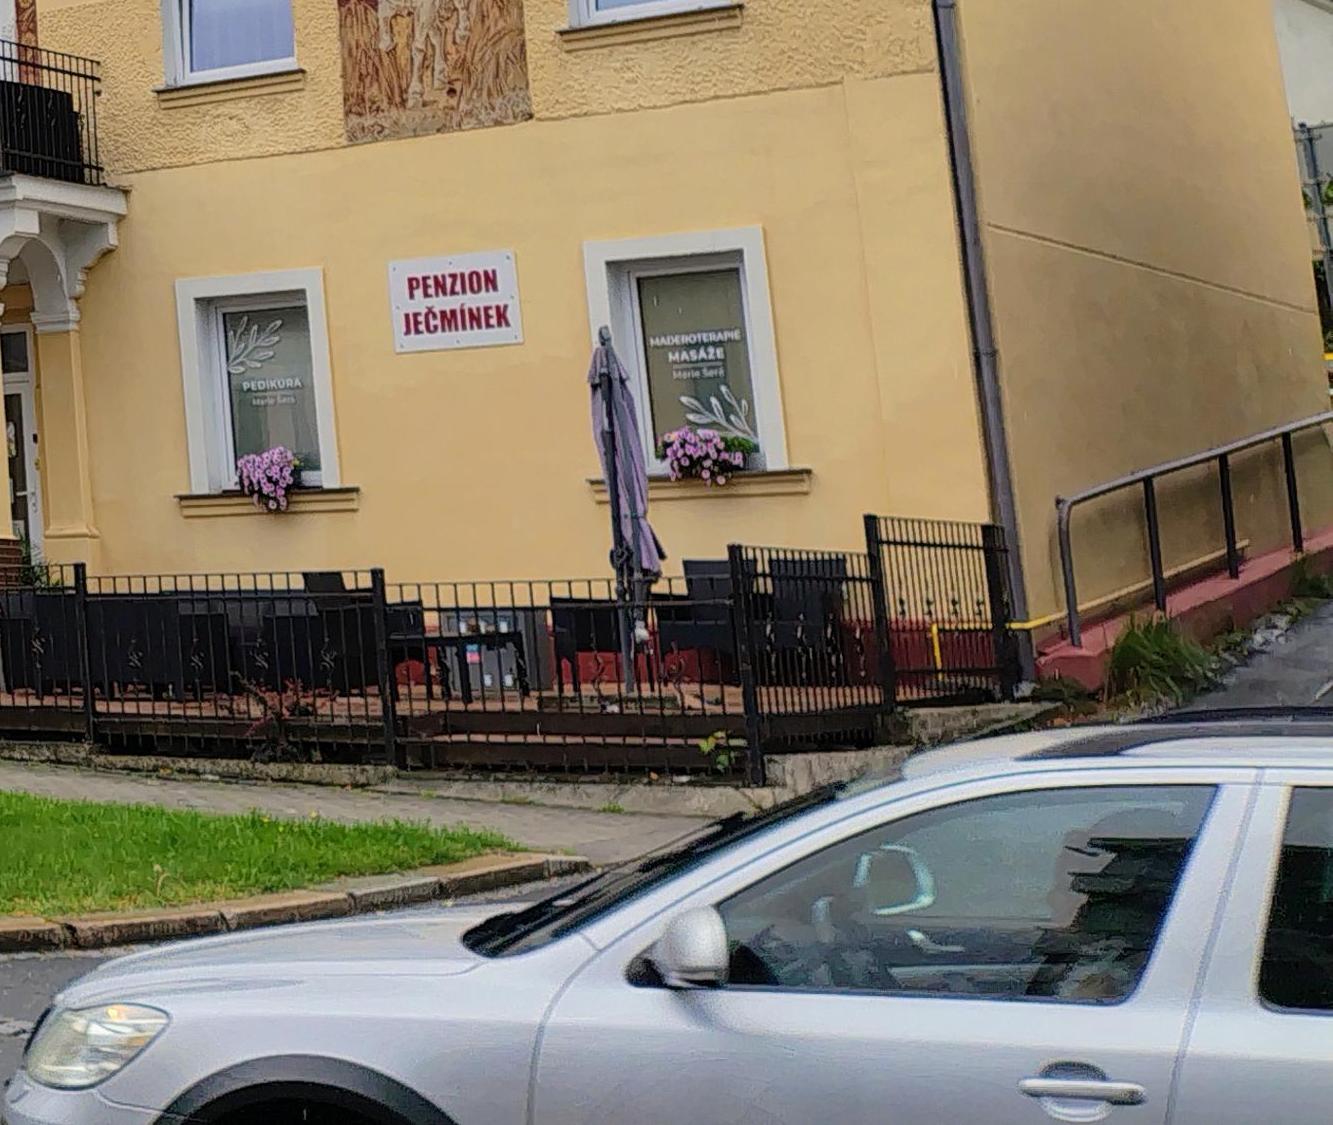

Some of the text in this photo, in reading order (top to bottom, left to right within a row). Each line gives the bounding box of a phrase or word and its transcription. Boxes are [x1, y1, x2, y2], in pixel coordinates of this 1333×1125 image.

[407, 268, 499, 300] PENZION
[403, 302, 511, 336] JEČMÍNEK
[668, 346, 725, 363] MASÁŽE
